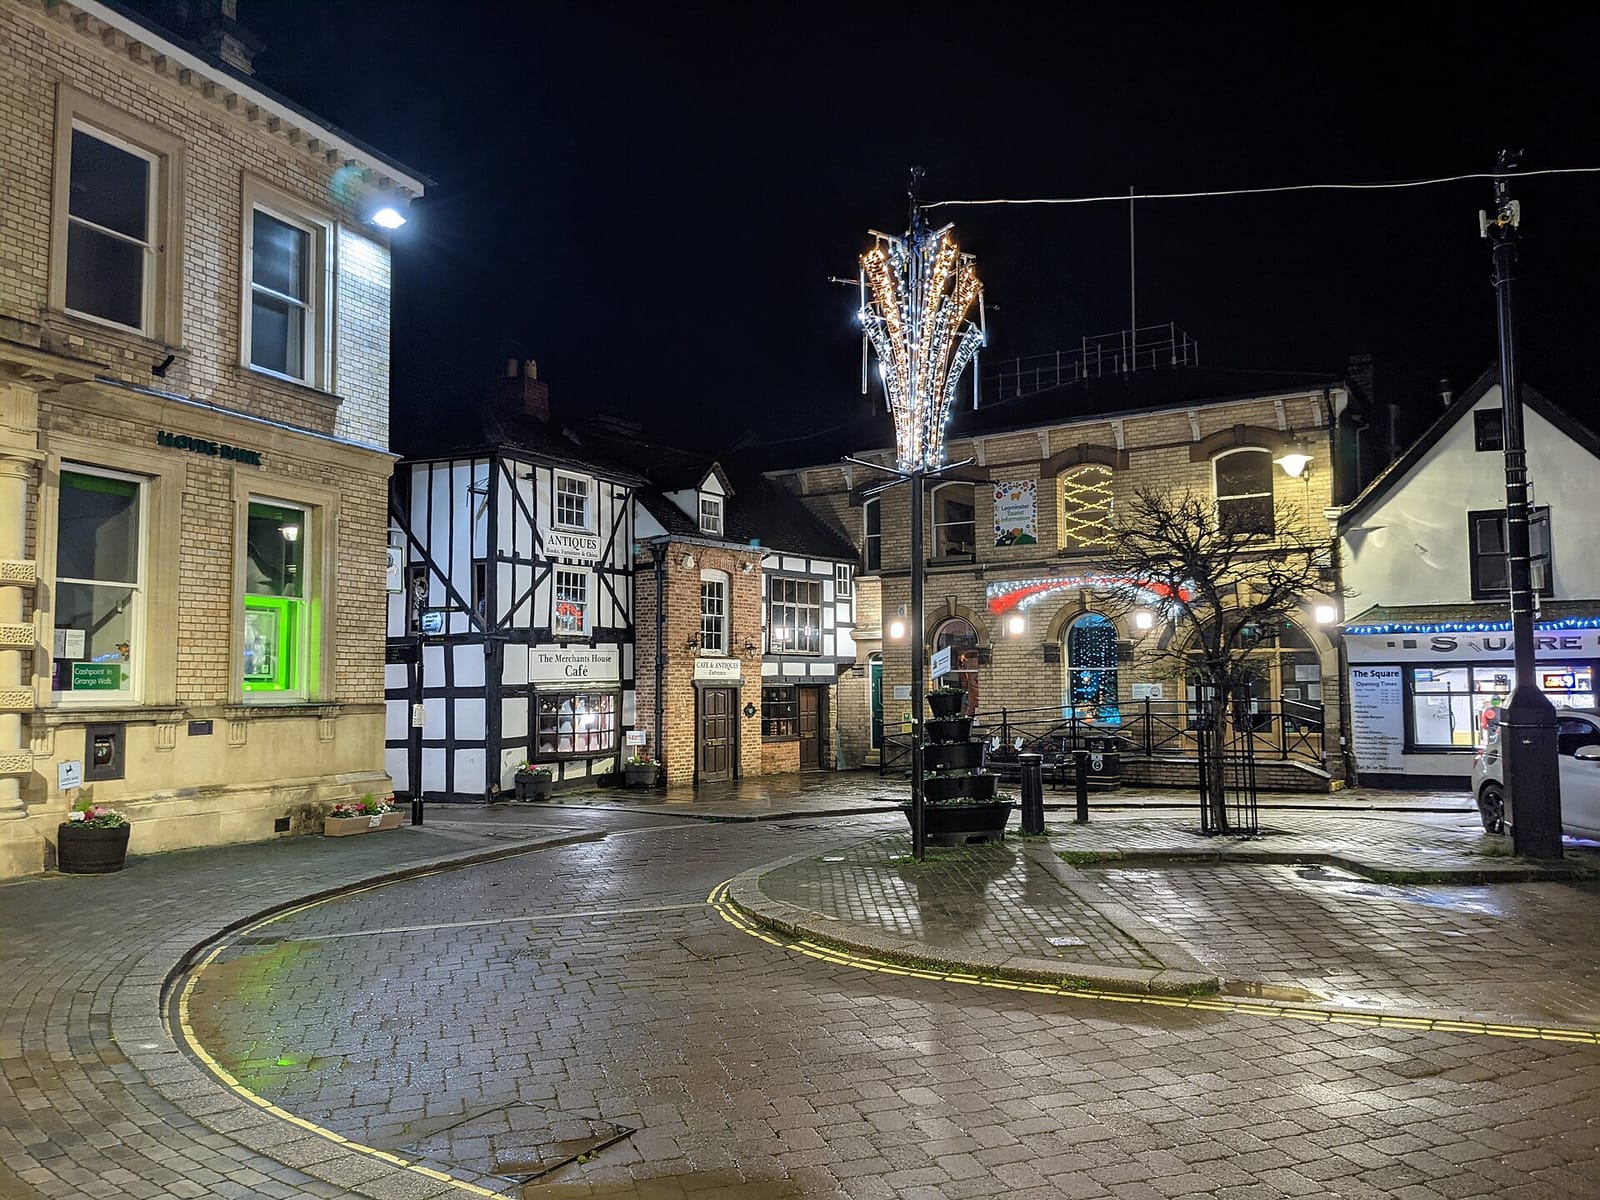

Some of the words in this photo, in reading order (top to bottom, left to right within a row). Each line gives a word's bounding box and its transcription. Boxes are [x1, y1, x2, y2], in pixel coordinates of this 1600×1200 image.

[548, 534, 597, 551] ANTIQUES
[538, 654, 553, 663] The
[554, 654, 590, 663] Merchants
[591, 654, 612, 663] House
[565, 665, 588, 677] Café
[715, 662, 739, 671] ANTIQUES
[75, 668, 105, 677] Cashpoint
[1353, 670, 1369, 678] The
[1370, 670, 1400, 679] Square
[75, 678, 97, 686] Grange
[98, 677, 112, 685] Walk
